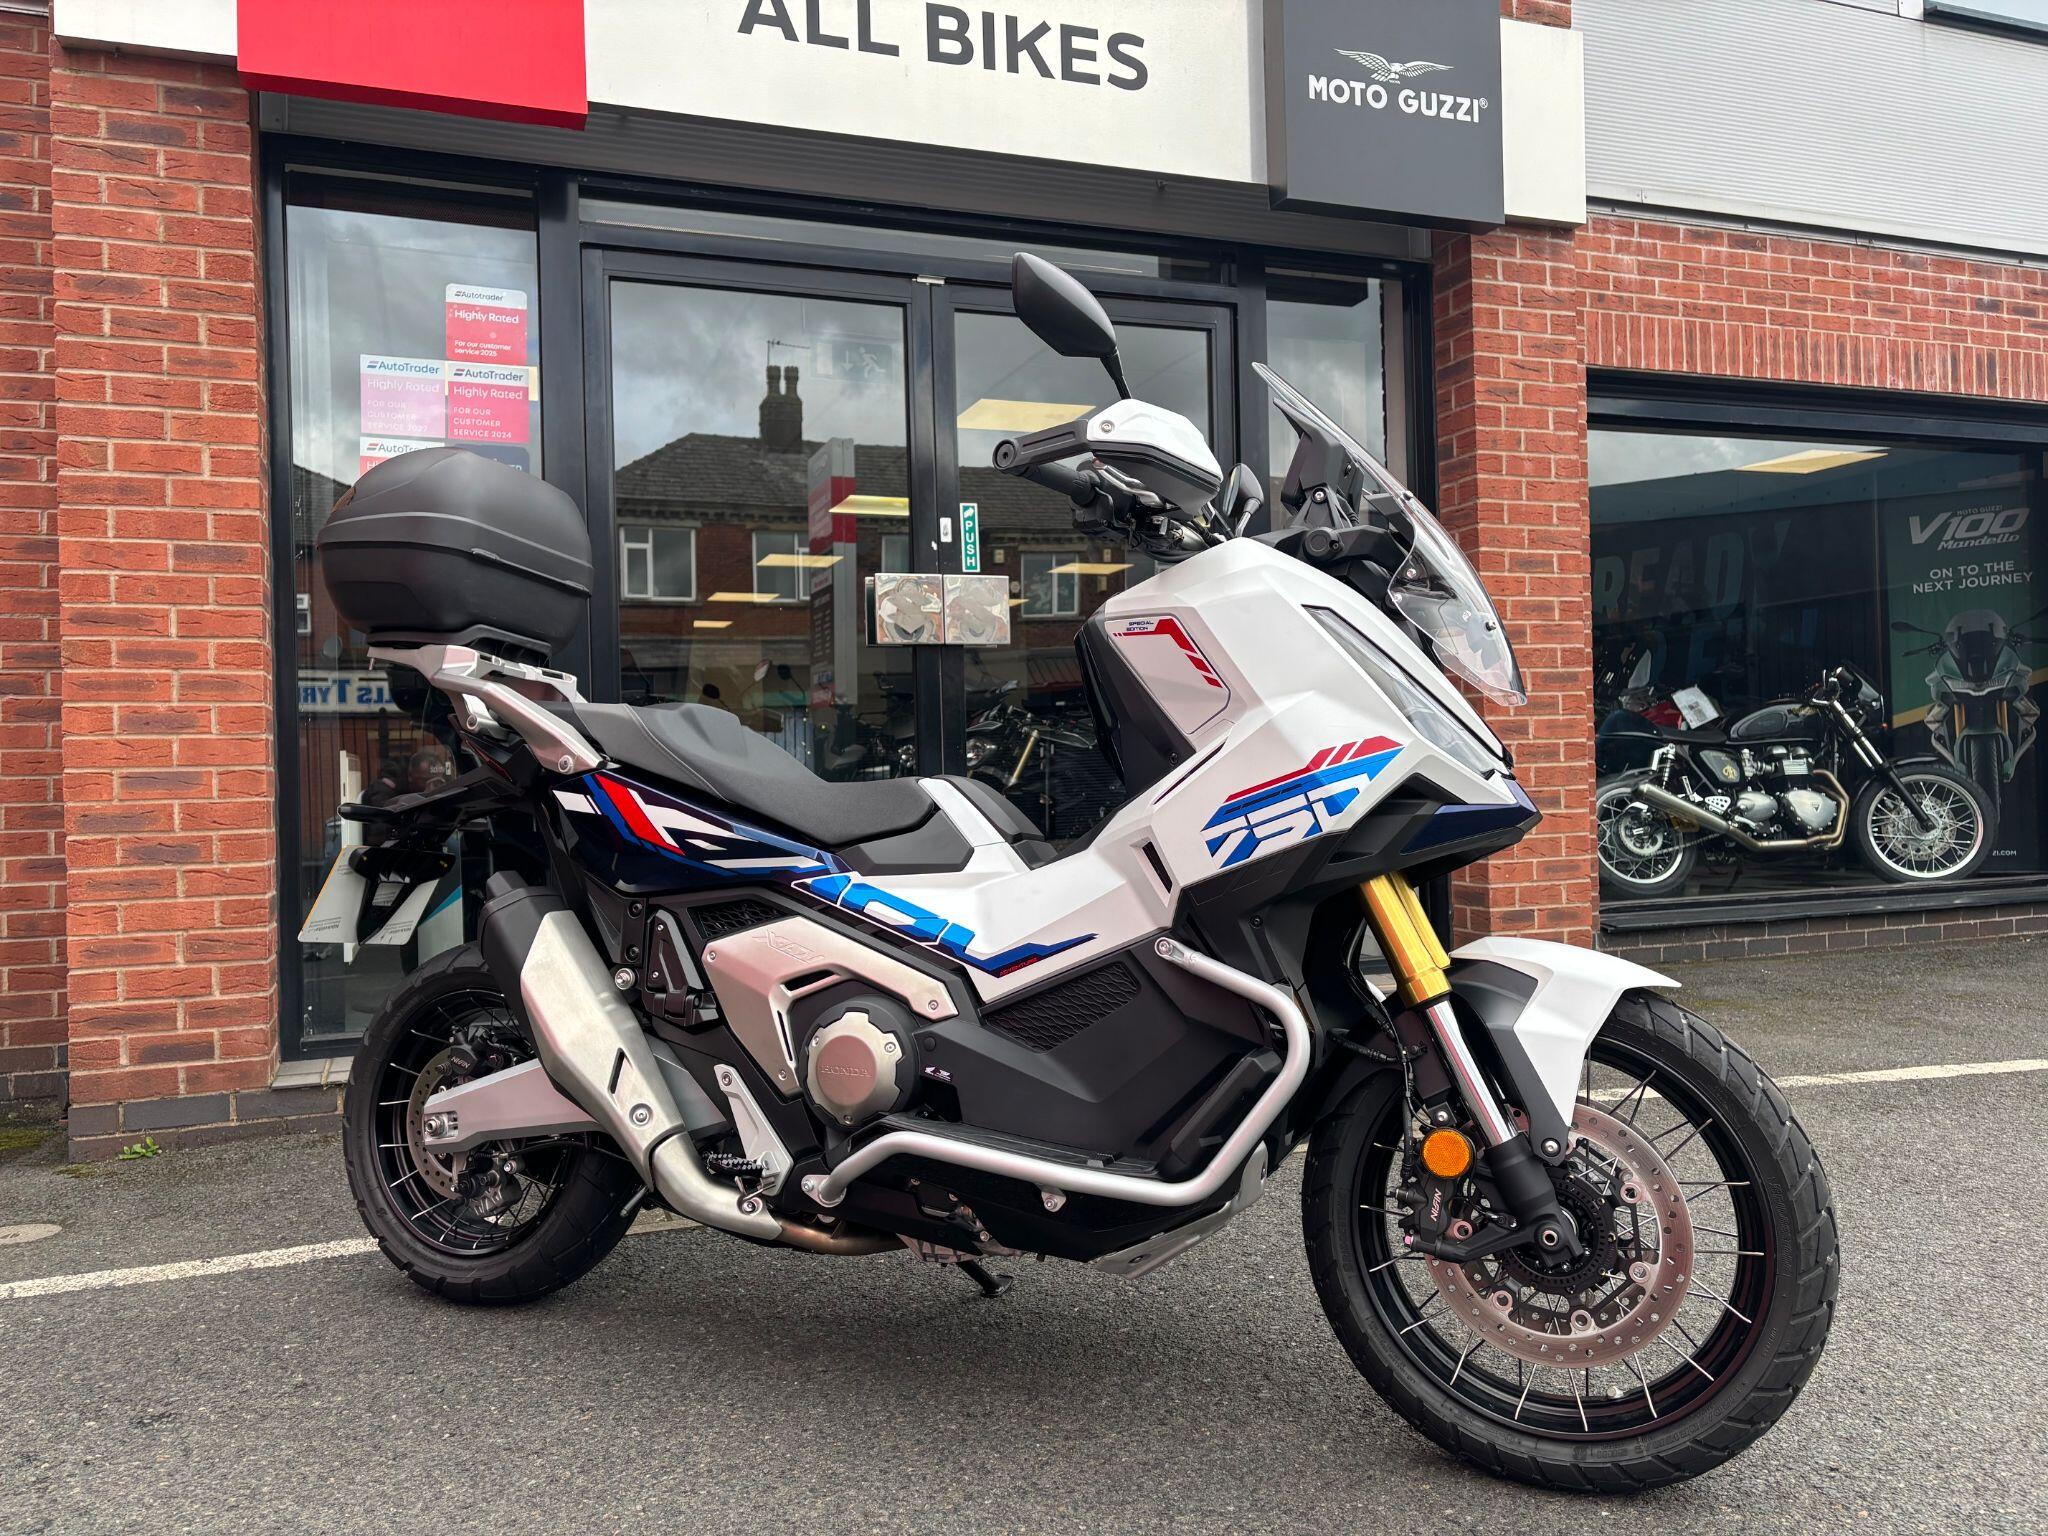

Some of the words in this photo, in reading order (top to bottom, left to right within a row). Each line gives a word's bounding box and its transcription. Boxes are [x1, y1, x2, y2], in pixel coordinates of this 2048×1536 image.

[737, 0, 900, 57] ALL
[925, 2, 1149, 91] BIKES
[1308, 74, 1388, 109] MOTO
[454, 310, 487, 322] Highly
[489, 313, 519, 323] Rated
[378, 361, 440, 374] AutoTrader
[465, 369, 524, 381] AutoTrader
[367, 379, 403, 392] Highly
[405, 382, 439, 393] Rated
[453, 386, 488, 399] Highly
[490, 389, 523, 400] Rated
[453, 418, 501, 427] CUSTOMER
[453, 429, 489, 438] SERVICE
[491, 431, 512, 439] 2024
[1909, 507, 2031, 545] V100
[965, 520, 976, 567] PUSH
[1937, 533, 2021, 551] Mandello
[1929, 568, 1953, 580] ON
[1958, 565, 1979, 576] TO
[1983, 560, 2015, 574] THE
[1913, 580, 1954, 594] NEXT
[1958, 572, 2033, 589] JOURNEY
[820, 1065, 873, 1078] HONDA
[1430, 1188, 1443, 1222] NISSIN
